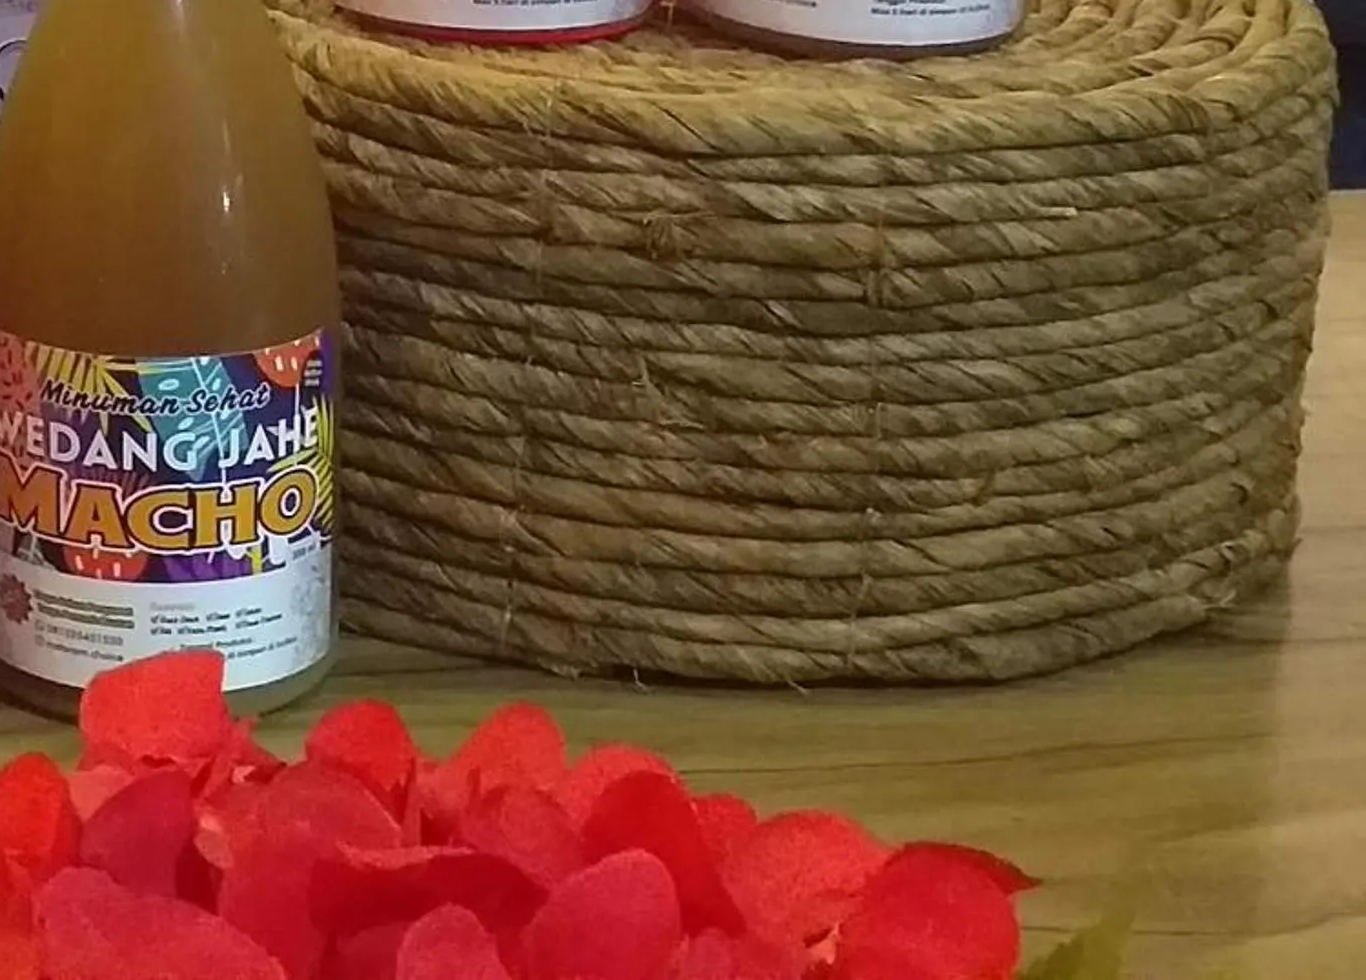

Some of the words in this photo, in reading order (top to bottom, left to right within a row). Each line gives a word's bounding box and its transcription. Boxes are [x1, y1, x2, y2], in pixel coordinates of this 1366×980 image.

[40, 379, 182, 417] Minuman
[184, 381, 270, 414] Sehat
[219, 404, 321, 468] JAHE
